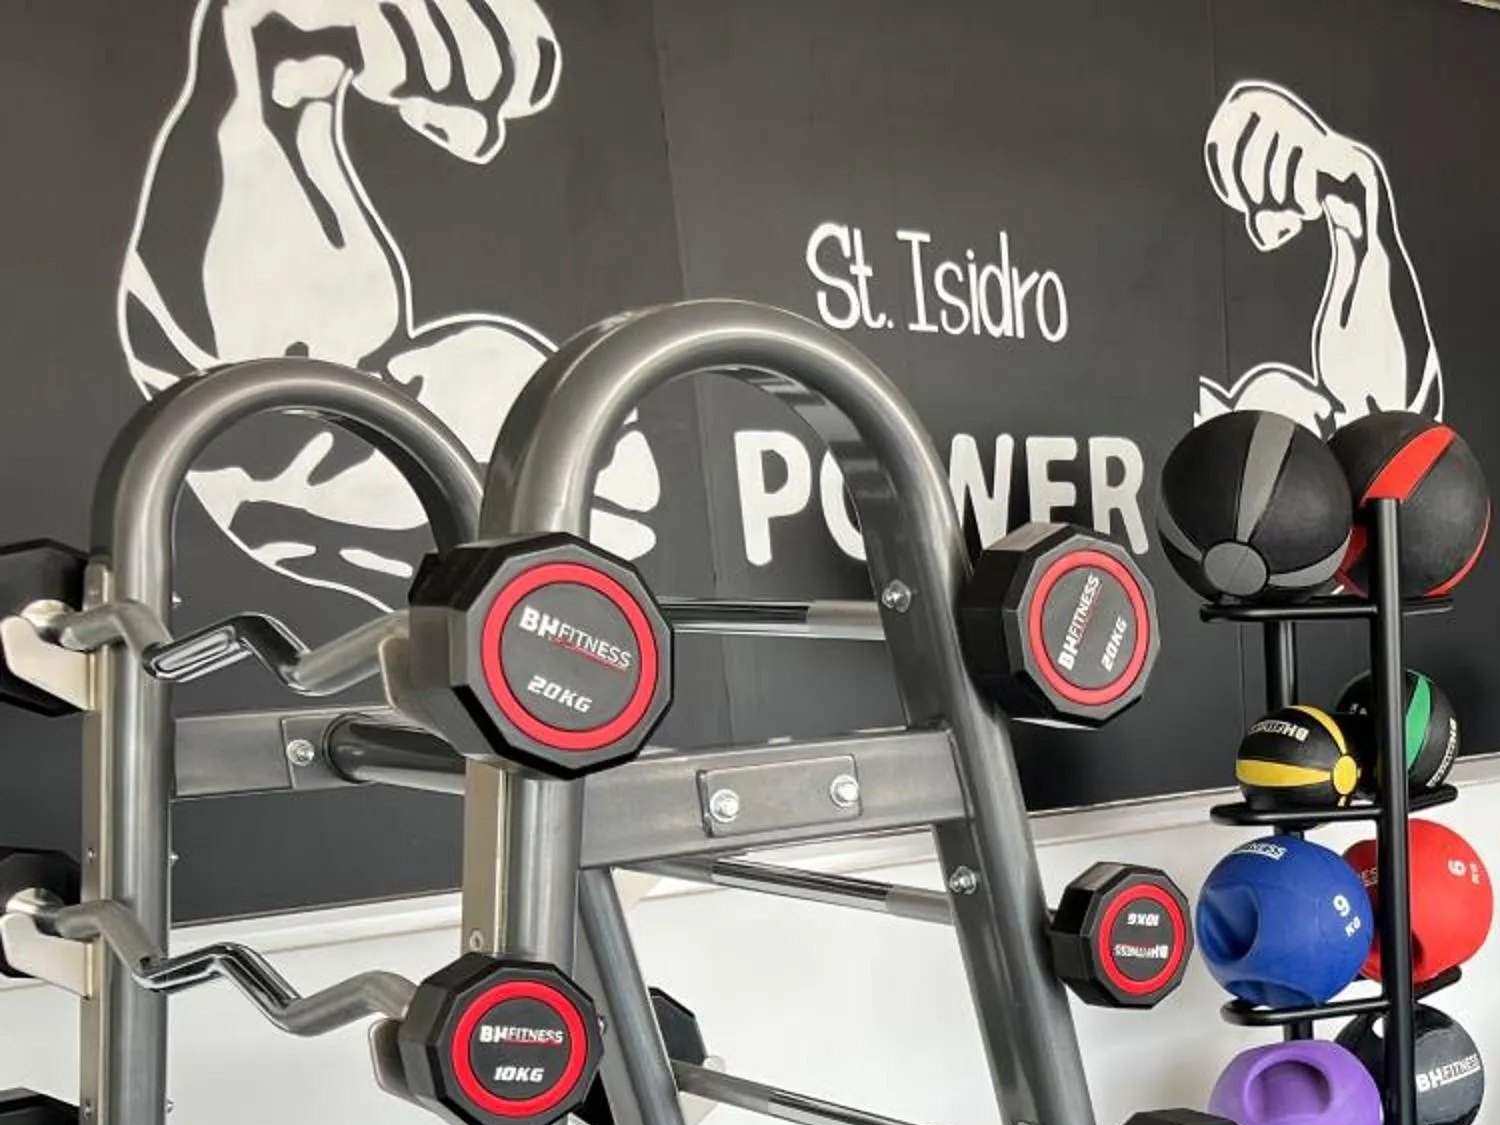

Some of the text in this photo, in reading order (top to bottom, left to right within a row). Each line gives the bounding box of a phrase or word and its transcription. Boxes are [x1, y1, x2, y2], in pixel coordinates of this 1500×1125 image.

[806, 222, 1069, 342] St. Isidro
[1101, 615, 1128, 673] 20KG
[527, 674, 593, 713] 20KG
[1127, 912, 1160, 927] 10KG
[1332, 894, 1351, 918] 9
[493, 1066, 545, 1084] 10KG
